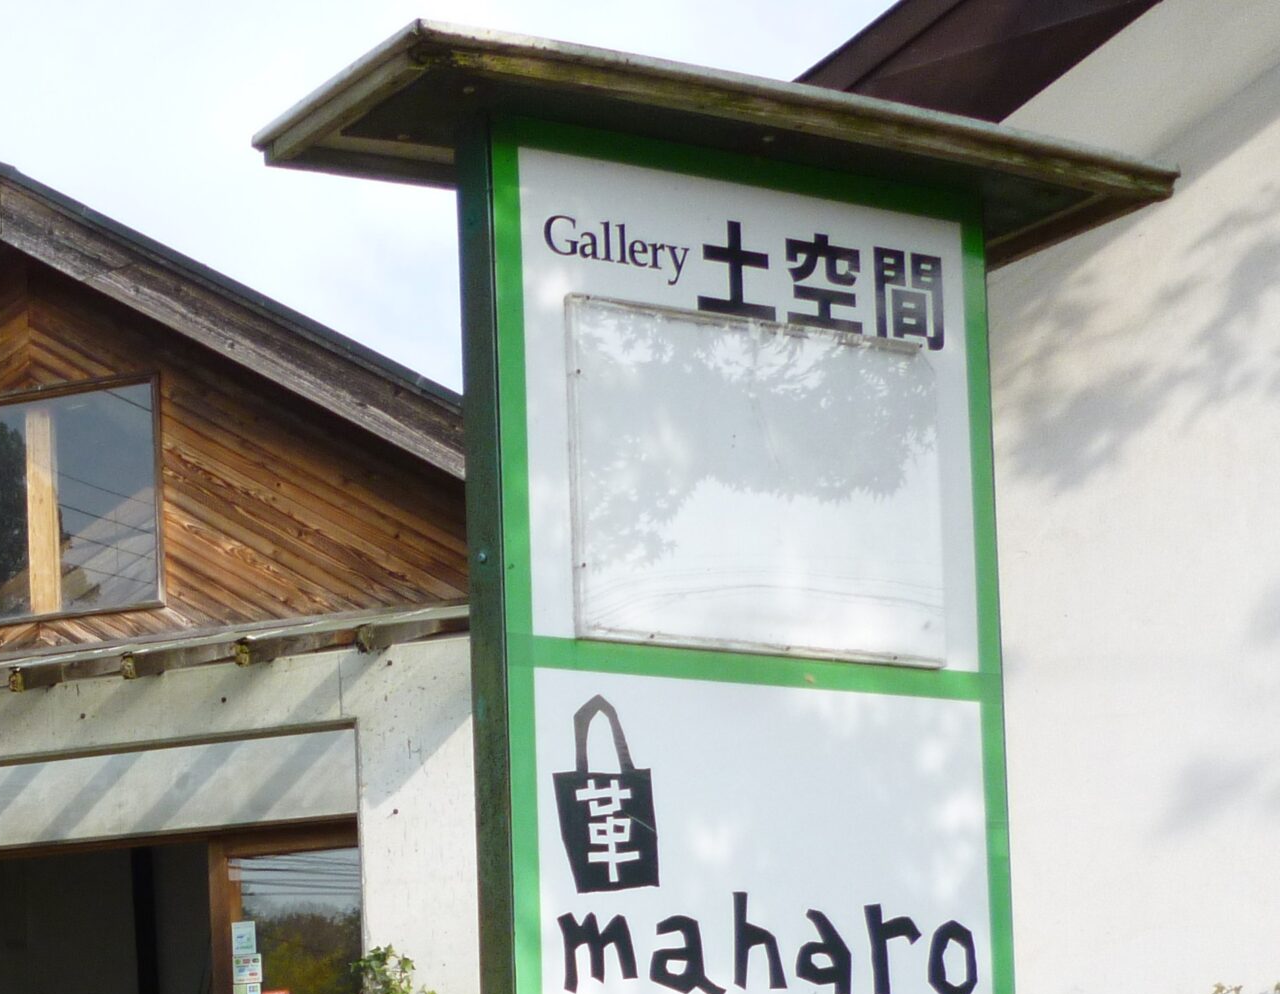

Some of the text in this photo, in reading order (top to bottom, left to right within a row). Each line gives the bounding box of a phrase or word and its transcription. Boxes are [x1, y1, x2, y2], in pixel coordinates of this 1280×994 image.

[543, 214, 690, 286] Gallery
[696, 219, 946, 351] 土空間
